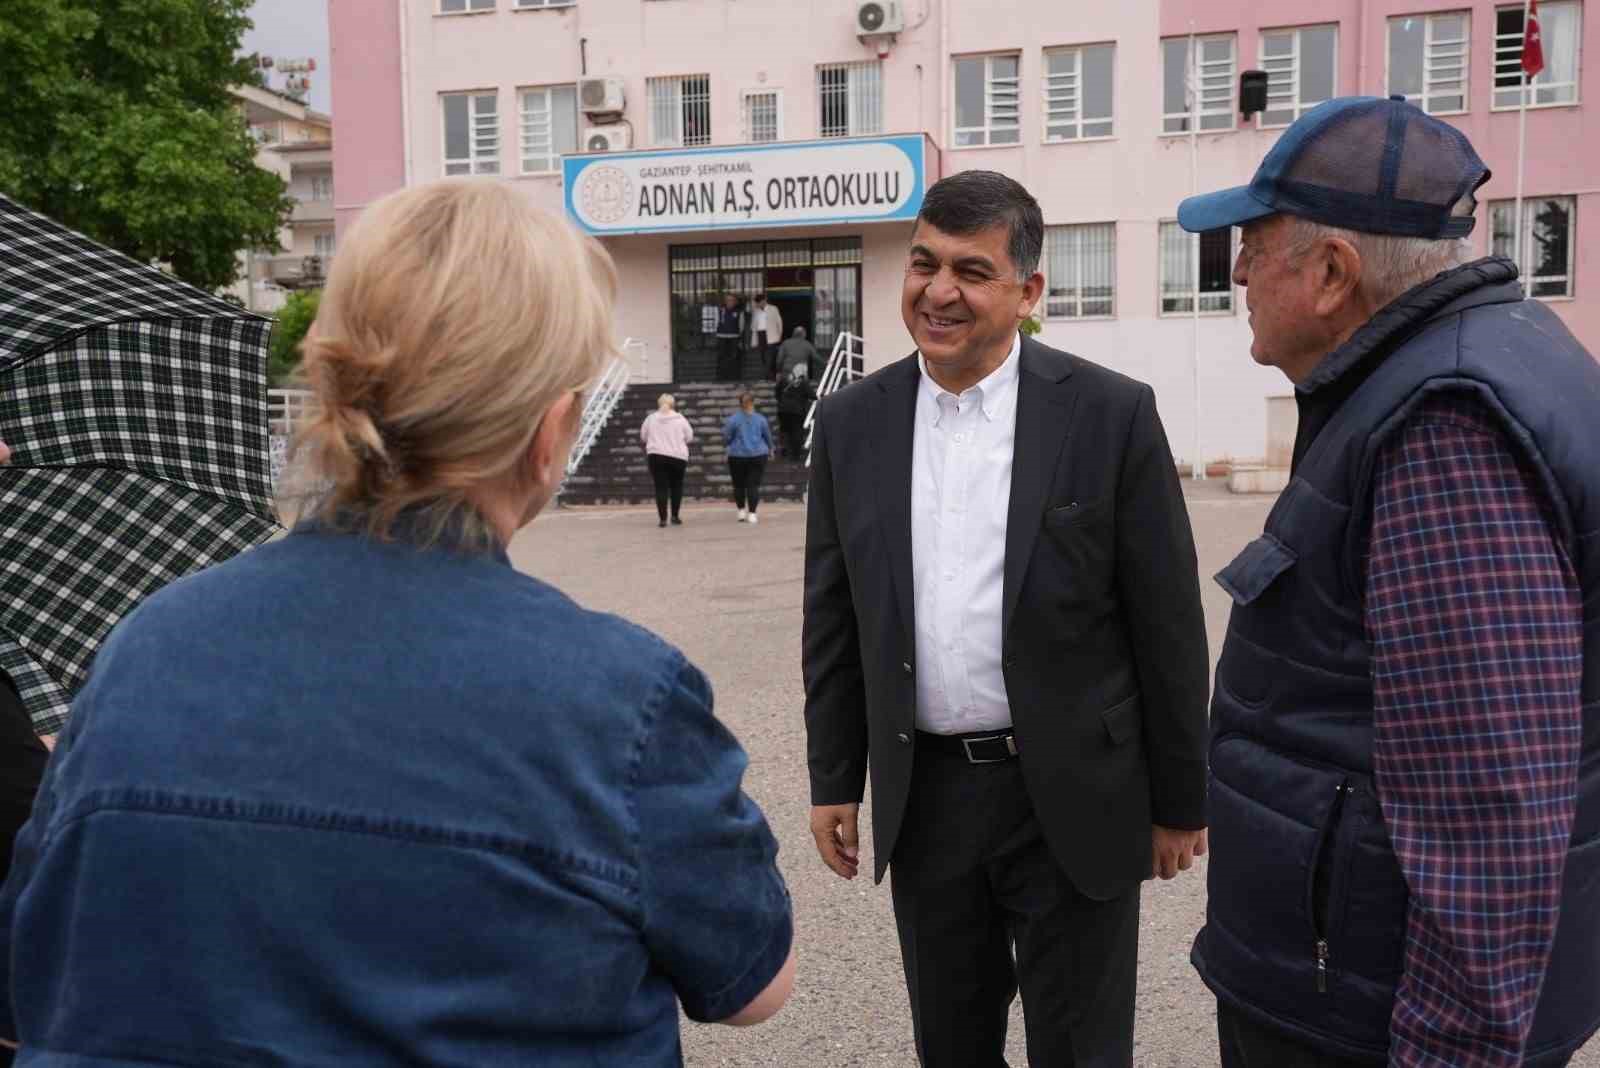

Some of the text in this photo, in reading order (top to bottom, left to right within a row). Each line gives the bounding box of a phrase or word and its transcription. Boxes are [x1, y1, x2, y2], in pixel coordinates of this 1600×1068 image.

[638, 171, 899, 218] ADNAN A.Ş. ORTAOKULU
